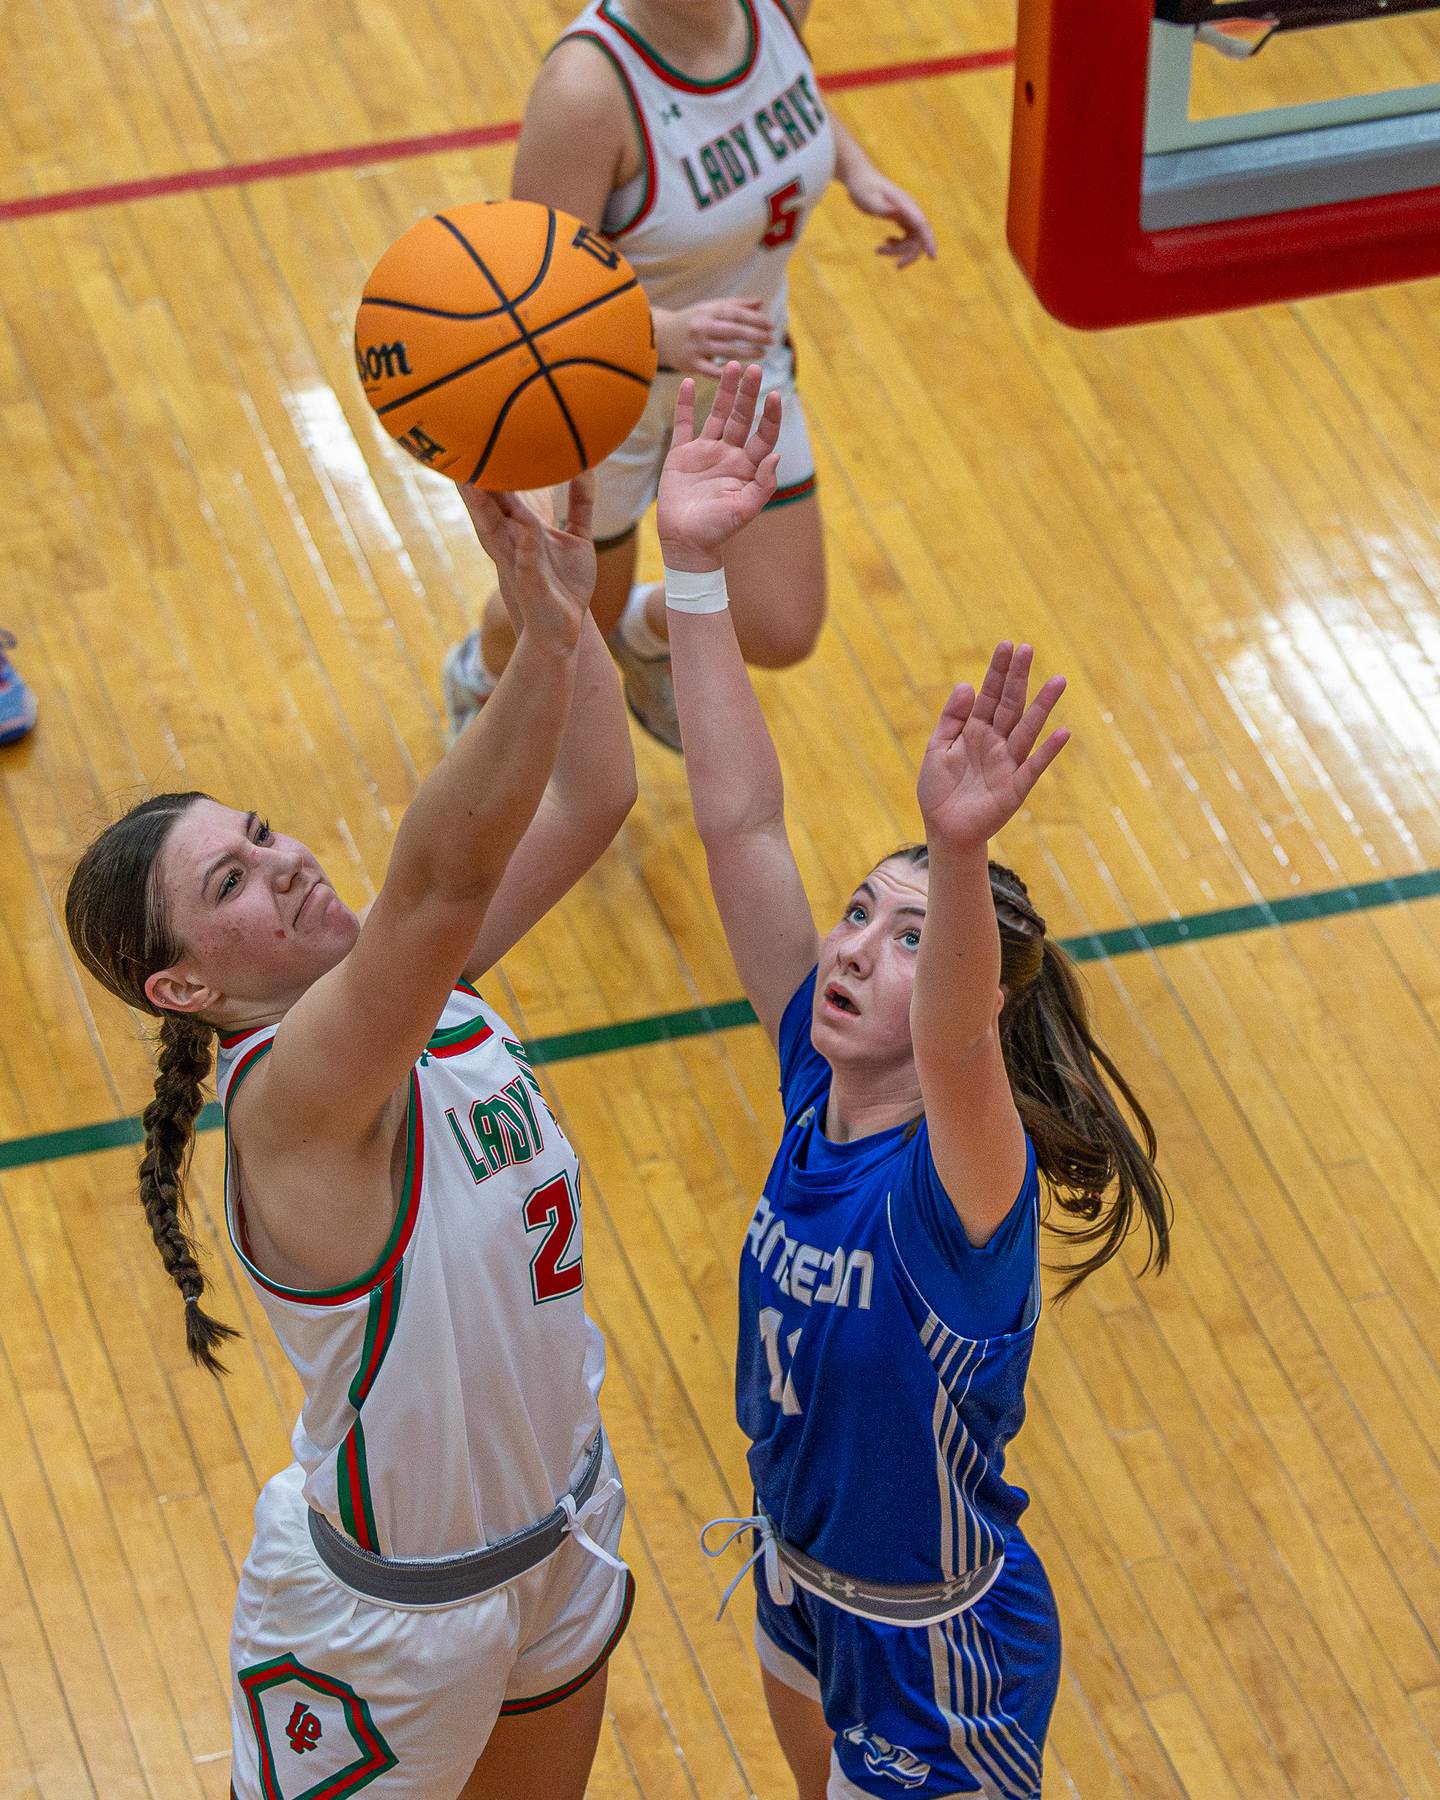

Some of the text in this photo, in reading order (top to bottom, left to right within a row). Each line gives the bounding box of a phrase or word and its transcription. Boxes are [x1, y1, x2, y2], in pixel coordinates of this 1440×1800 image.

[679, 121, 760, 212] LADY
[759, 173, 806, 251] 5
[445, 1075, 544, 1184] LADY
[522, 1168, 583, 1305] 2
